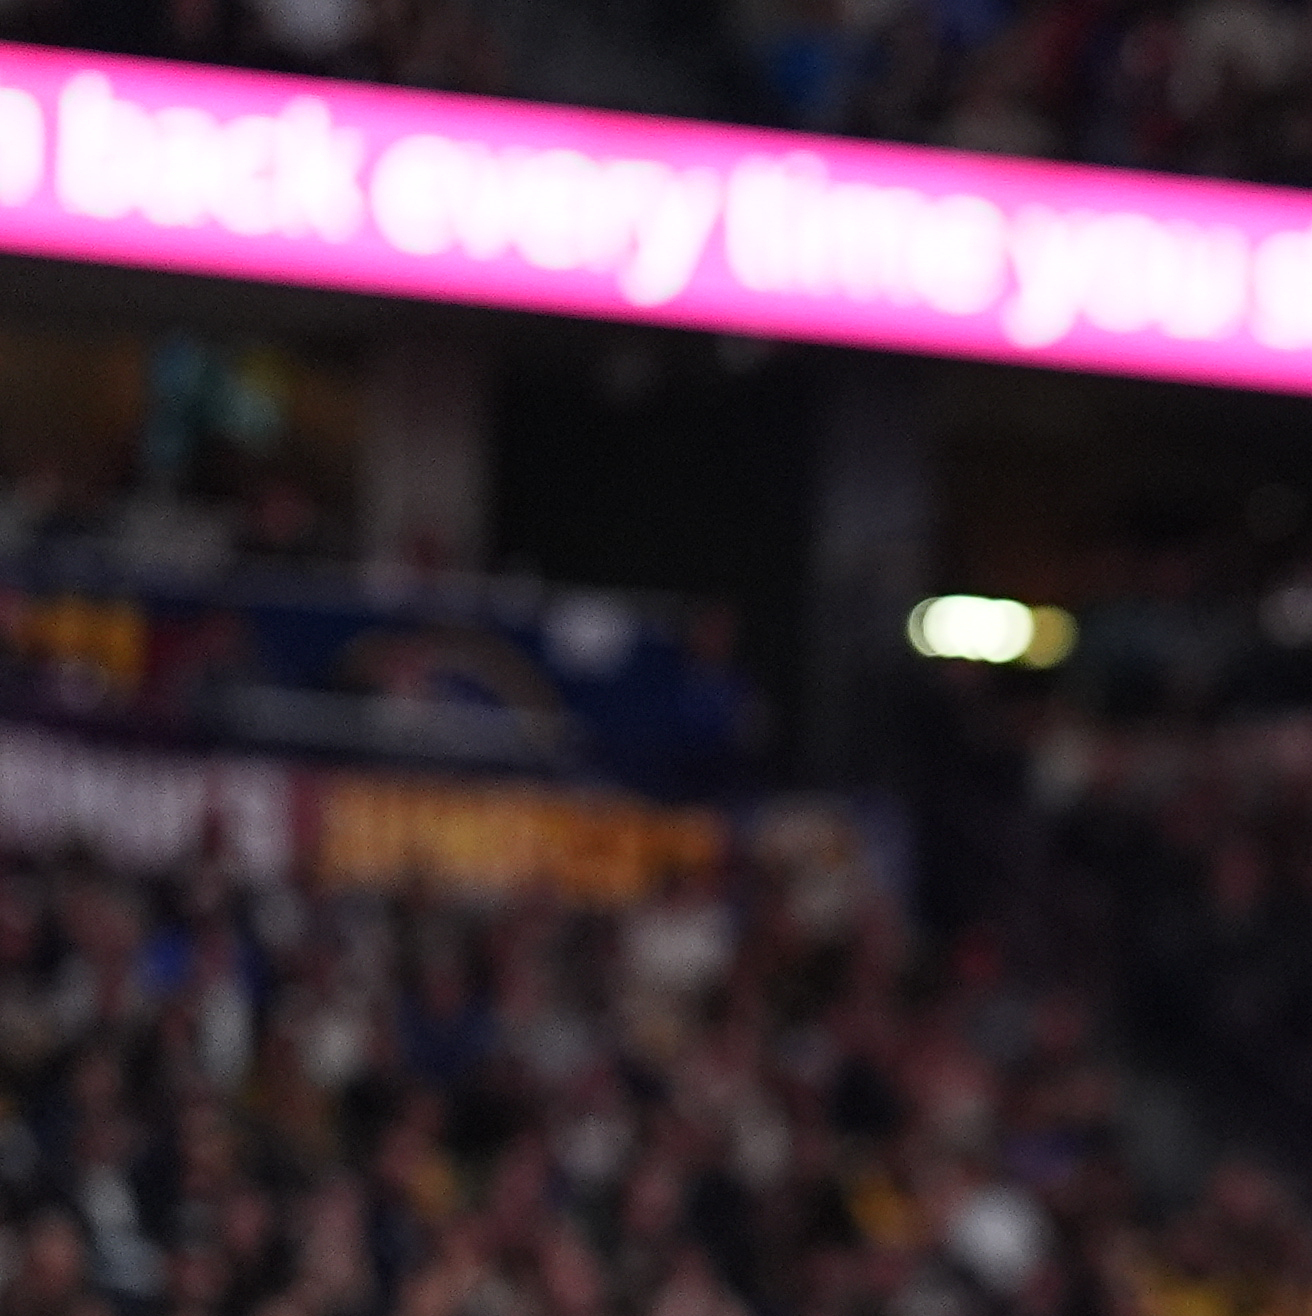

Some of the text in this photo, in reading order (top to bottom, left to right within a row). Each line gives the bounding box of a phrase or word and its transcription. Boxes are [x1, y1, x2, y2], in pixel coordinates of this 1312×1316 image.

[56, 70, 367, 245] back
[371, 134, 720, 308] every
[724, 150, 1005, 316] time
[1003, 204, 1250, 350] you
